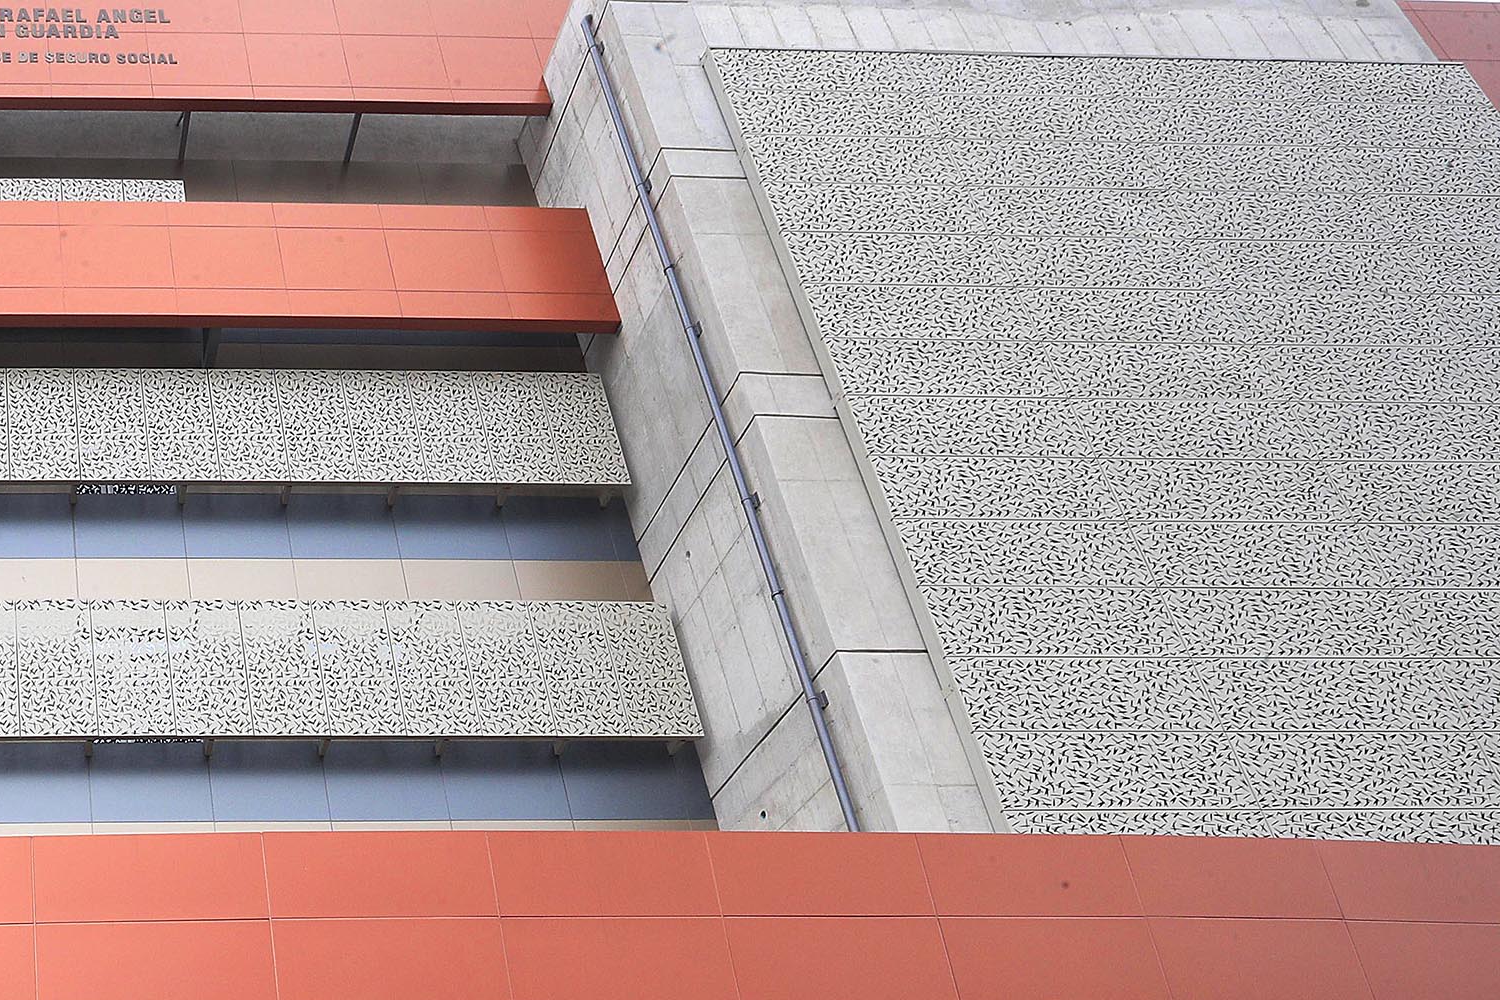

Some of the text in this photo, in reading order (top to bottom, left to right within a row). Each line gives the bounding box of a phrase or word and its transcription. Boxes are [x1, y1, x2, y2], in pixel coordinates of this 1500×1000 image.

[0, 8, 87, 23] RAFAEL
[97, 9, 171, 23] ANGEL
[15, 24, 120, 39] GUARDIA
[18, 52, 38, 64] DE
[45, 52, 110, 64] SEGURO
[116, 53, 178, 65] SOCIAL
